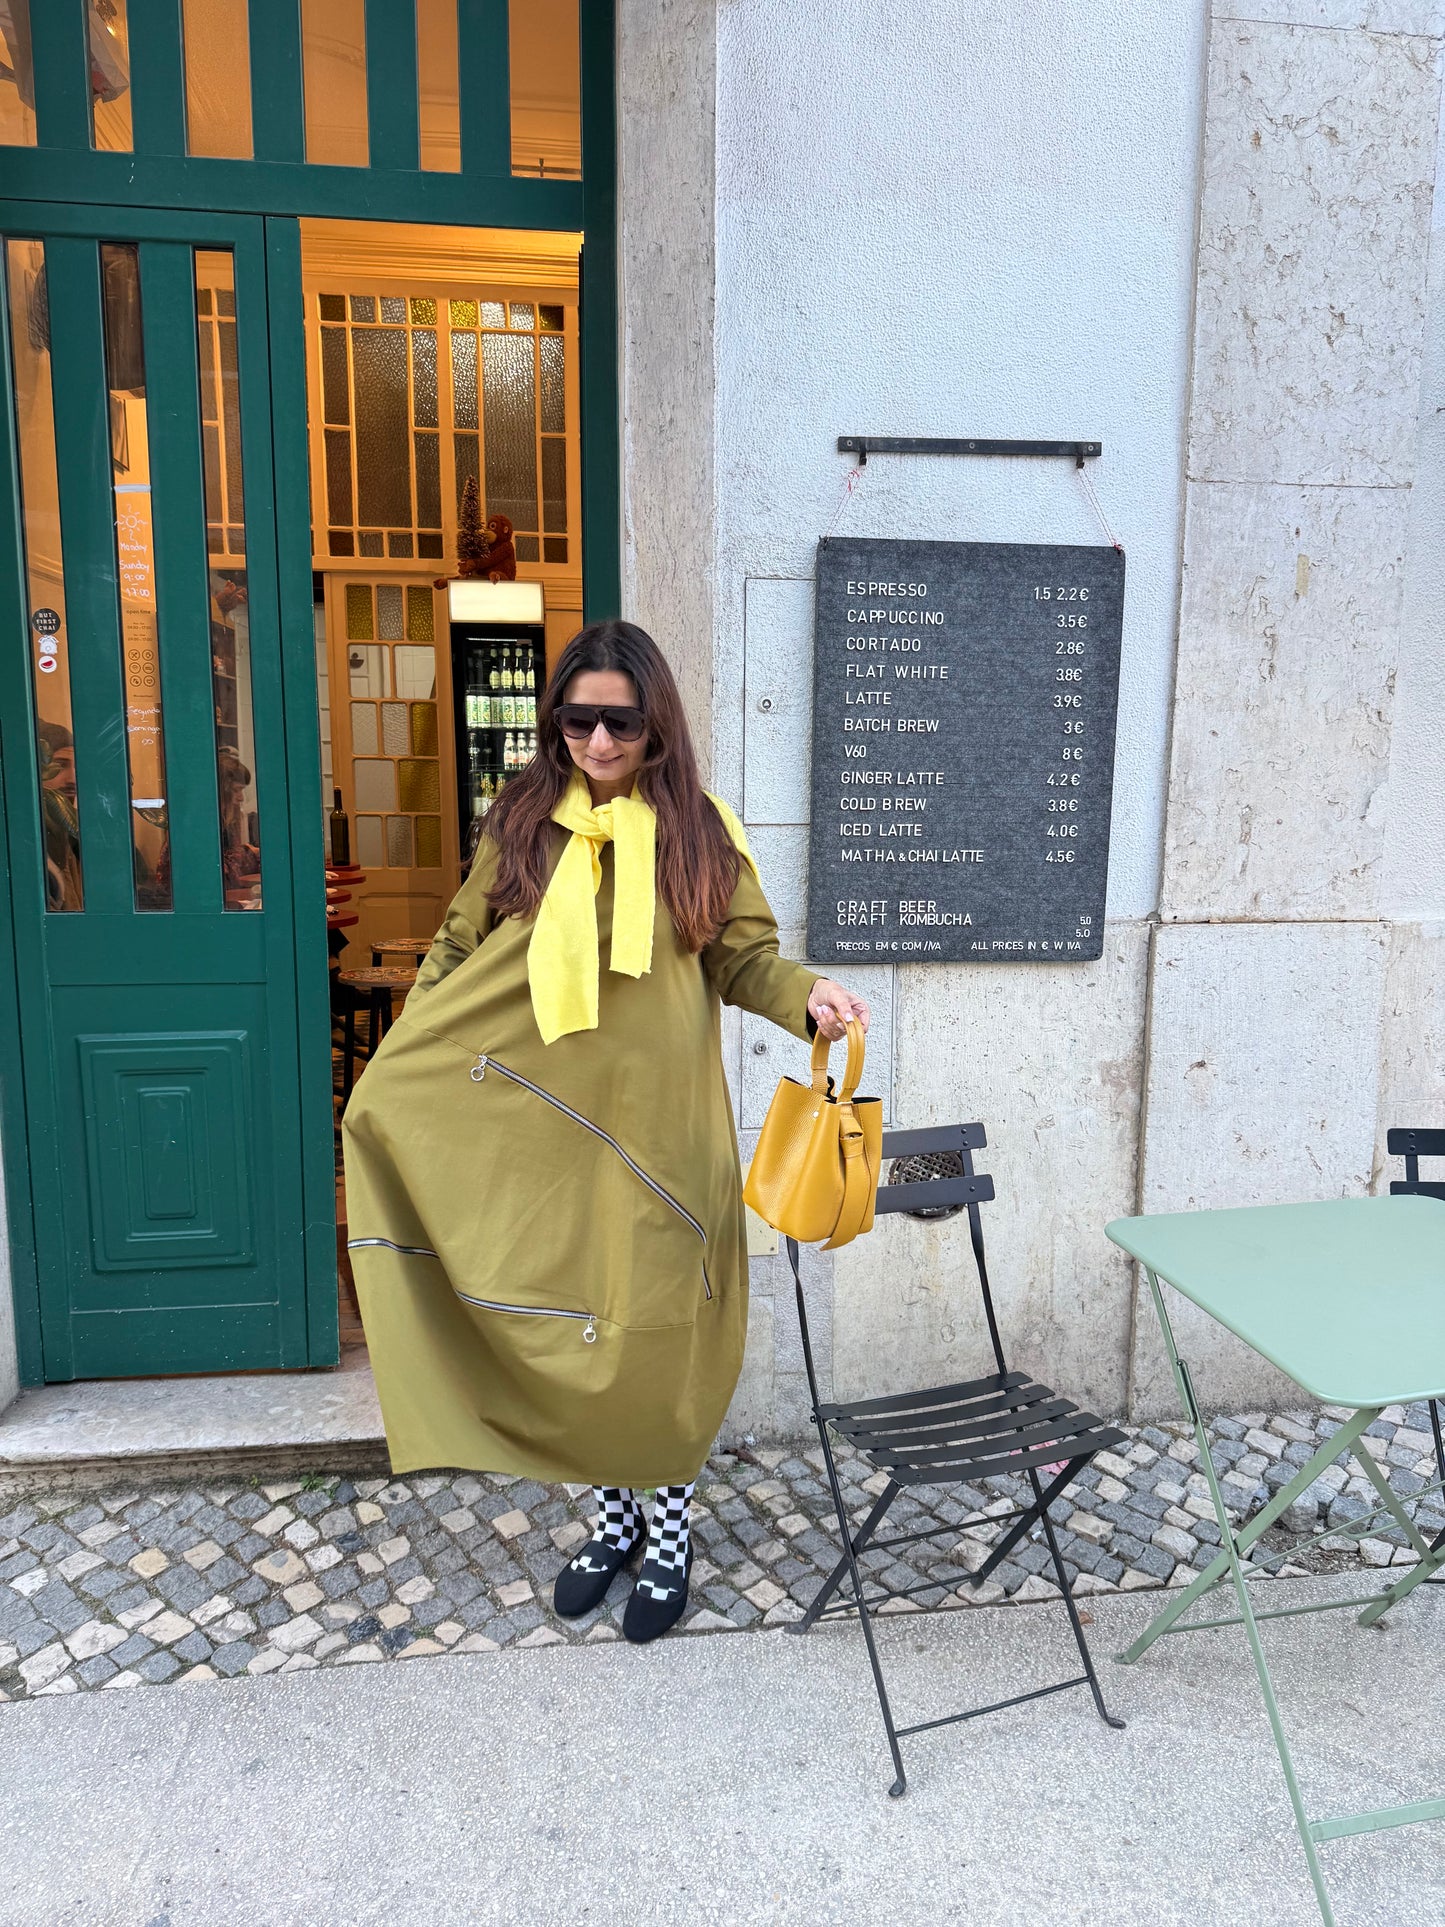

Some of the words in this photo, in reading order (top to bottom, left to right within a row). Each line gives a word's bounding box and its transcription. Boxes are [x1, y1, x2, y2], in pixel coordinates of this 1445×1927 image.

[119, 560, 149, 573] Sunday
[847, 581, 926, 596] ESPRESSO
[1034, 587, 1050, 599] 1.5
[1057, 587, 1089, 601] 2.2€
[848, 609, 943, 624] CAPPUCCINO
[1057, 615, 1087, 627] 3.5€
[847, 637, 920, 651] CORTADO
[1056, 642, 1084, 654] 2.8€
[847, 664, 885, 677] FLAT
[895, 666, 948, 678] WHITE
[846, 691, 891, 704] LATTE
[1054, 695, 1082, 707] 3.9€
[845, 718, 890, 731] BATCH
[898, 719, 939, 732] BREW
[845, 745, 866, 757] V60
[841, 771, 892, 784] GINGER
[898, 772, 944, 784] LATTE
[841, 798, 876, 810] COLD
[883, 798, 926, 810] BREW
[1048, 799, 1078, 811] 3.8€
[840, 824, 871, 835] ICED
[880, 824, 922, 836] LATTE
[1047, 825, 1078, 837] 4.0€
[842, 850, 895, 862] MATHA
[909, 850, 937, 862] CHAI
[943, 850, 984, 862] LATTE
[1046, 851, 1075, 862] 4.5€
[837, 901, 887, 912] CRAFT
[899, 901, 936, 912] BEER
[838, 913, 887, 925] CRAFT
[900, 913, 972, 925] KOMBUCHA
[1076, 929, 1090, 937] 5.0
[836, 942, 870, 950] PRECOS
[876, 942, 888, 950] EM
[891, 942, 898, 950] €
[902, 942, 921, 950] COM
[971, 942, 988, 950] ALL
[993, 941, 1023, 949] PRICES
[1042, 941, 1048, 950] €
[1067, 942, 1081, 950] IVA
